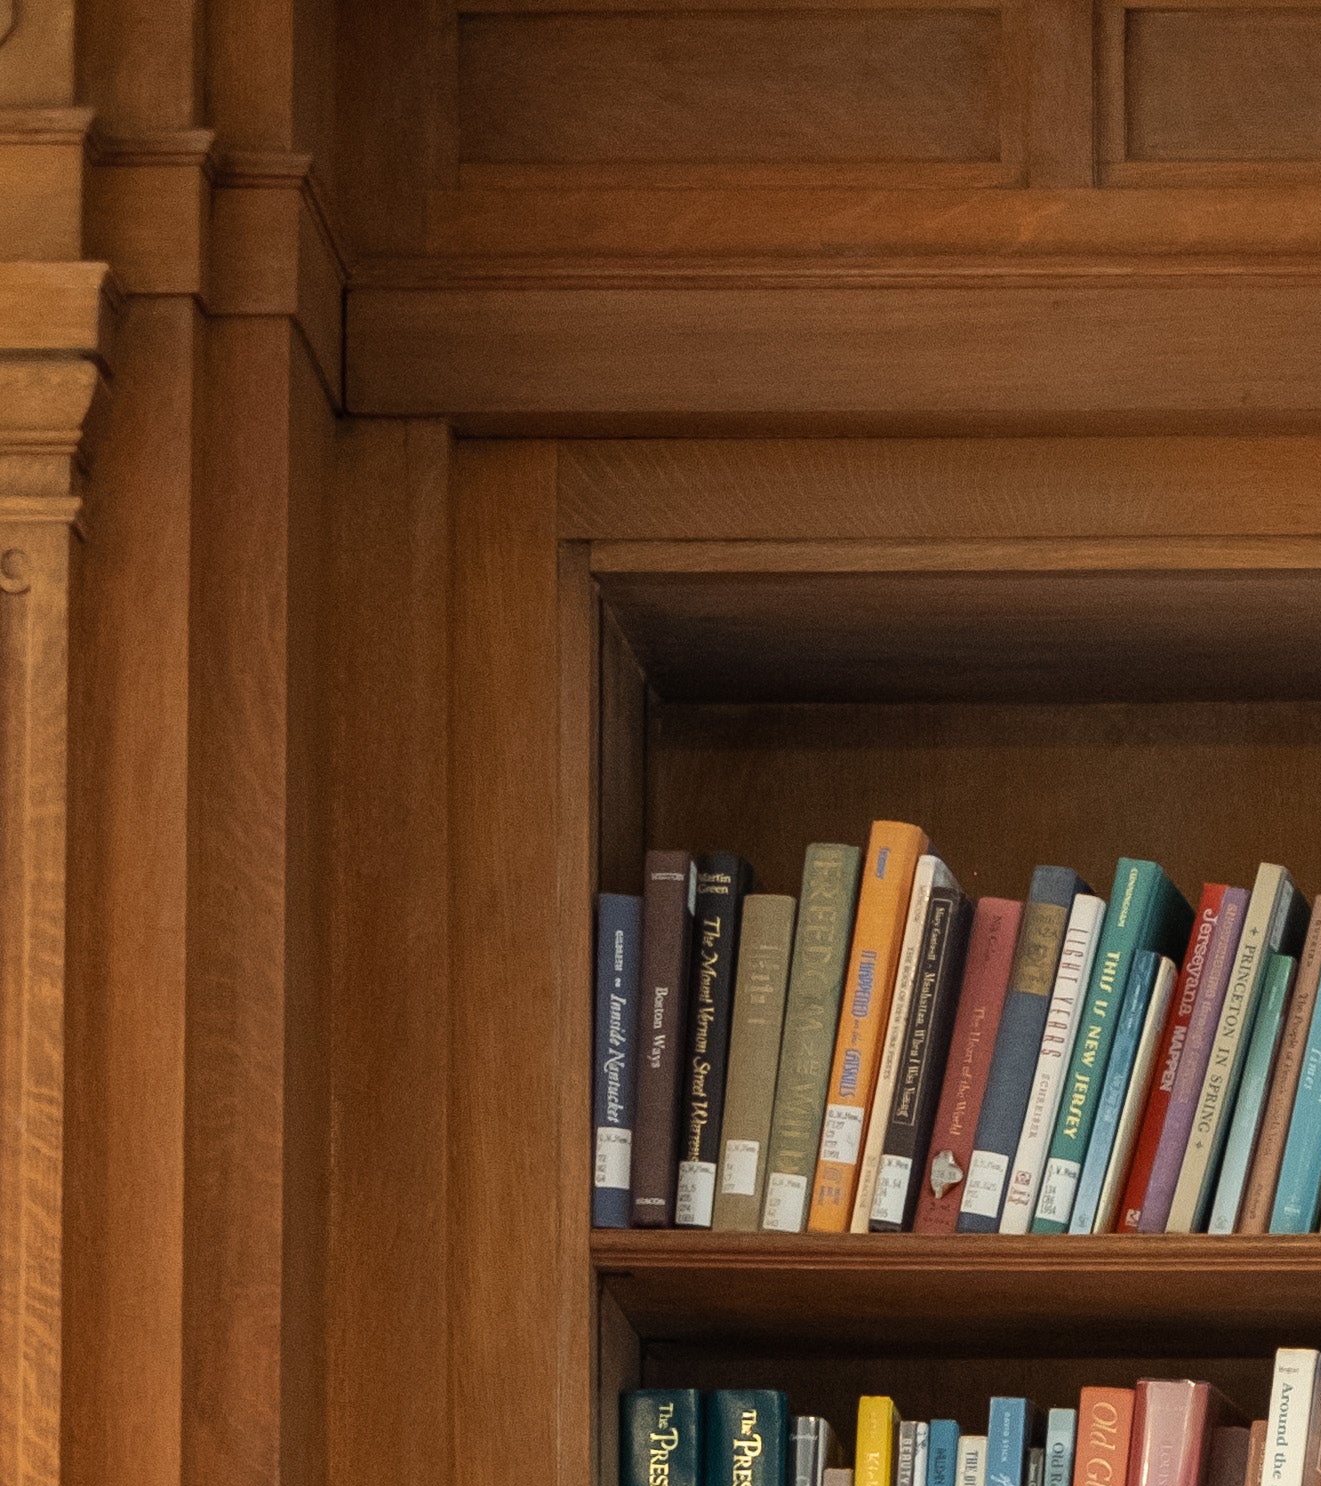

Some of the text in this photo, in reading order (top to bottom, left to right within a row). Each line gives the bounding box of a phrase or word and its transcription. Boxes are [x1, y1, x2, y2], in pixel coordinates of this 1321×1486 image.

[609, 993, 629, 1047] Innside
[650, 987, 669, 1068] Boston Ways
[1160, 908, 1219, 1092] Jerseyana MAPPEN
[1063, 951, 1121, 1140] THIS IS NEW JERSEY
[1197, 945, 1258, 1134] PRINCETON IN SPRING
[605, 1049, 627, 1122] Nantucket
[658, 1403, 674, 1428] The
[741, 1410, 757, 1435] The
[1275, 1382, 1294, 1446] Around
[1272, 1453, 1287, 1479] the
